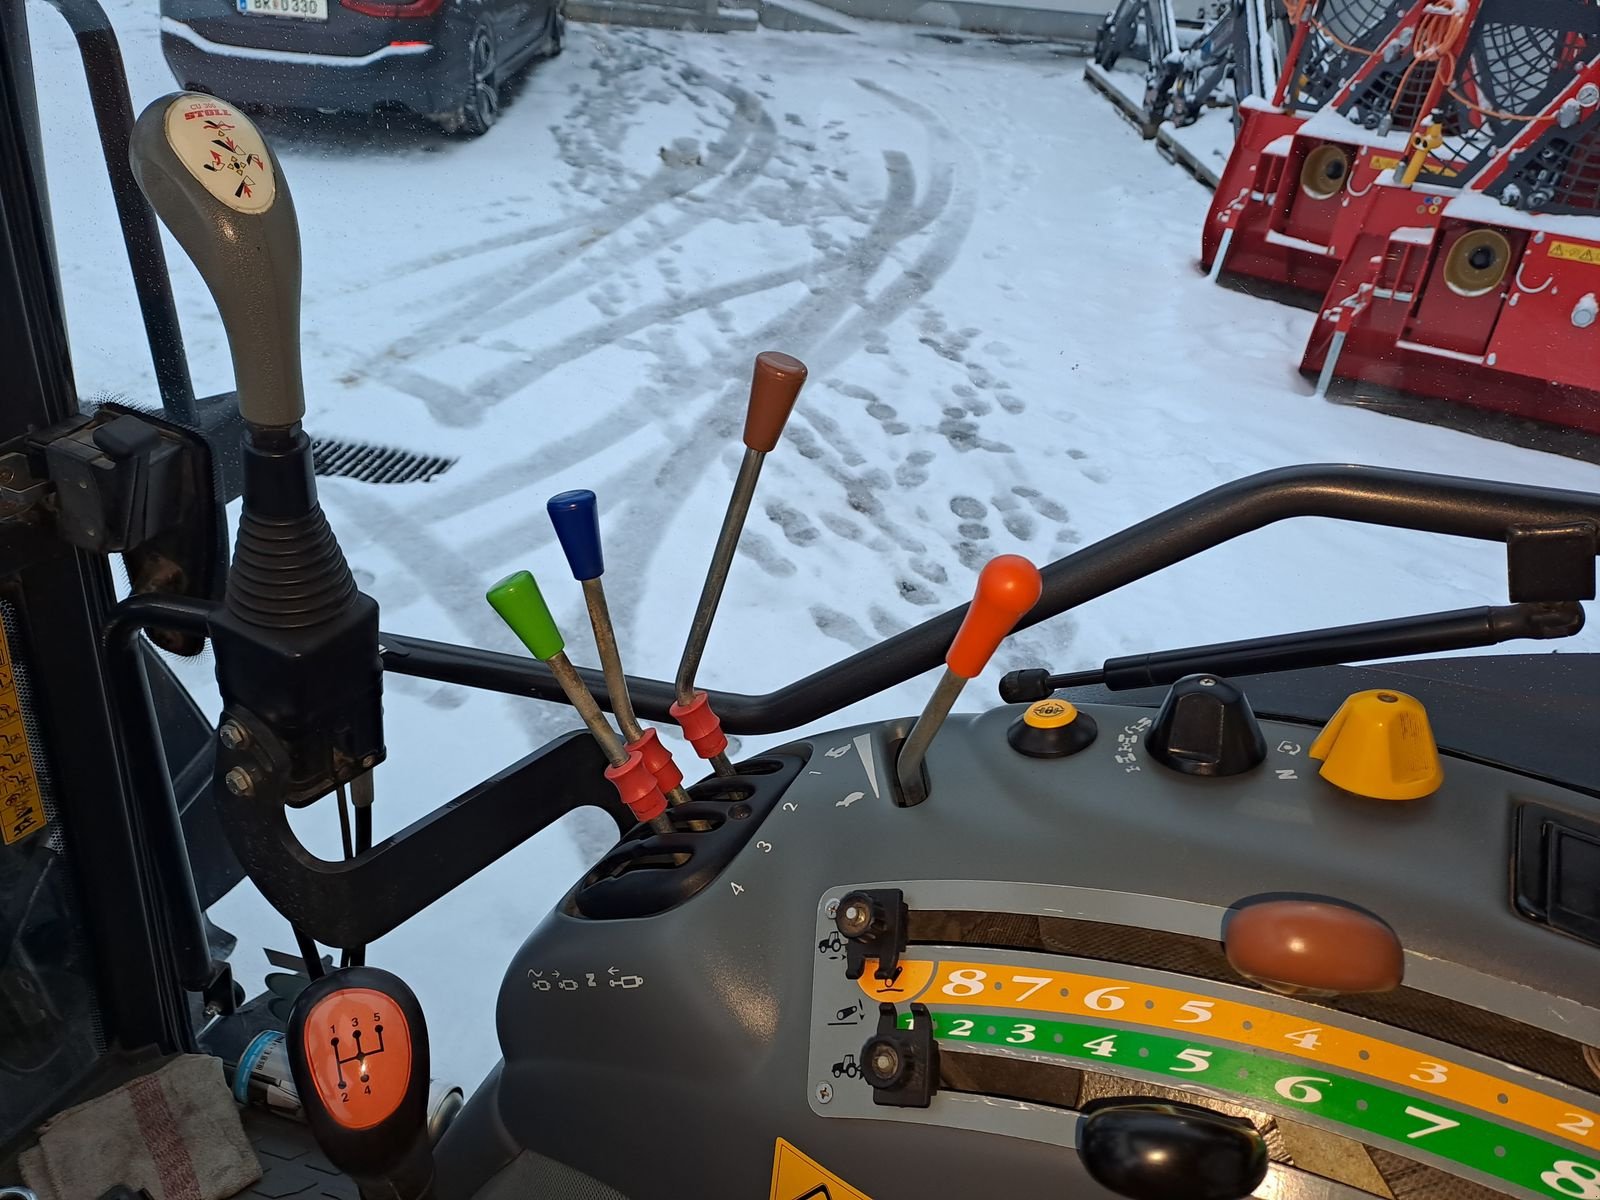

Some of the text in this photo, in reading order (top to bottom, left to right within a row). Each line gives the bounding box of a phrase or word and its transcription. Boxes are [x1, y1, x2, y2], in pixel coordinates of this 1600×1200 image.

[184, 109, 232, 120] STOLL
[756, 840, 772, 853] 3
[730, 881, 745, 896] 4
[330, 1012, 381, 1034] 1 3 5
[942, 969, 1595, 1136] 8 7 6 5 4 3 2
[341, 1085, 371, 1103] 2 4
[948, 1019, 975, 1037] 2
[1005, 1023, 1036, 1044] 3
[1082, 1034, 1118, 1057] 4
[1169, 1048, 1214, 1073] 5
[1275, 1076, 1331, 1104] 6
[1404, 1106, 1461, 1139] 7
[1540, 1160, 1600, 1200] 8
